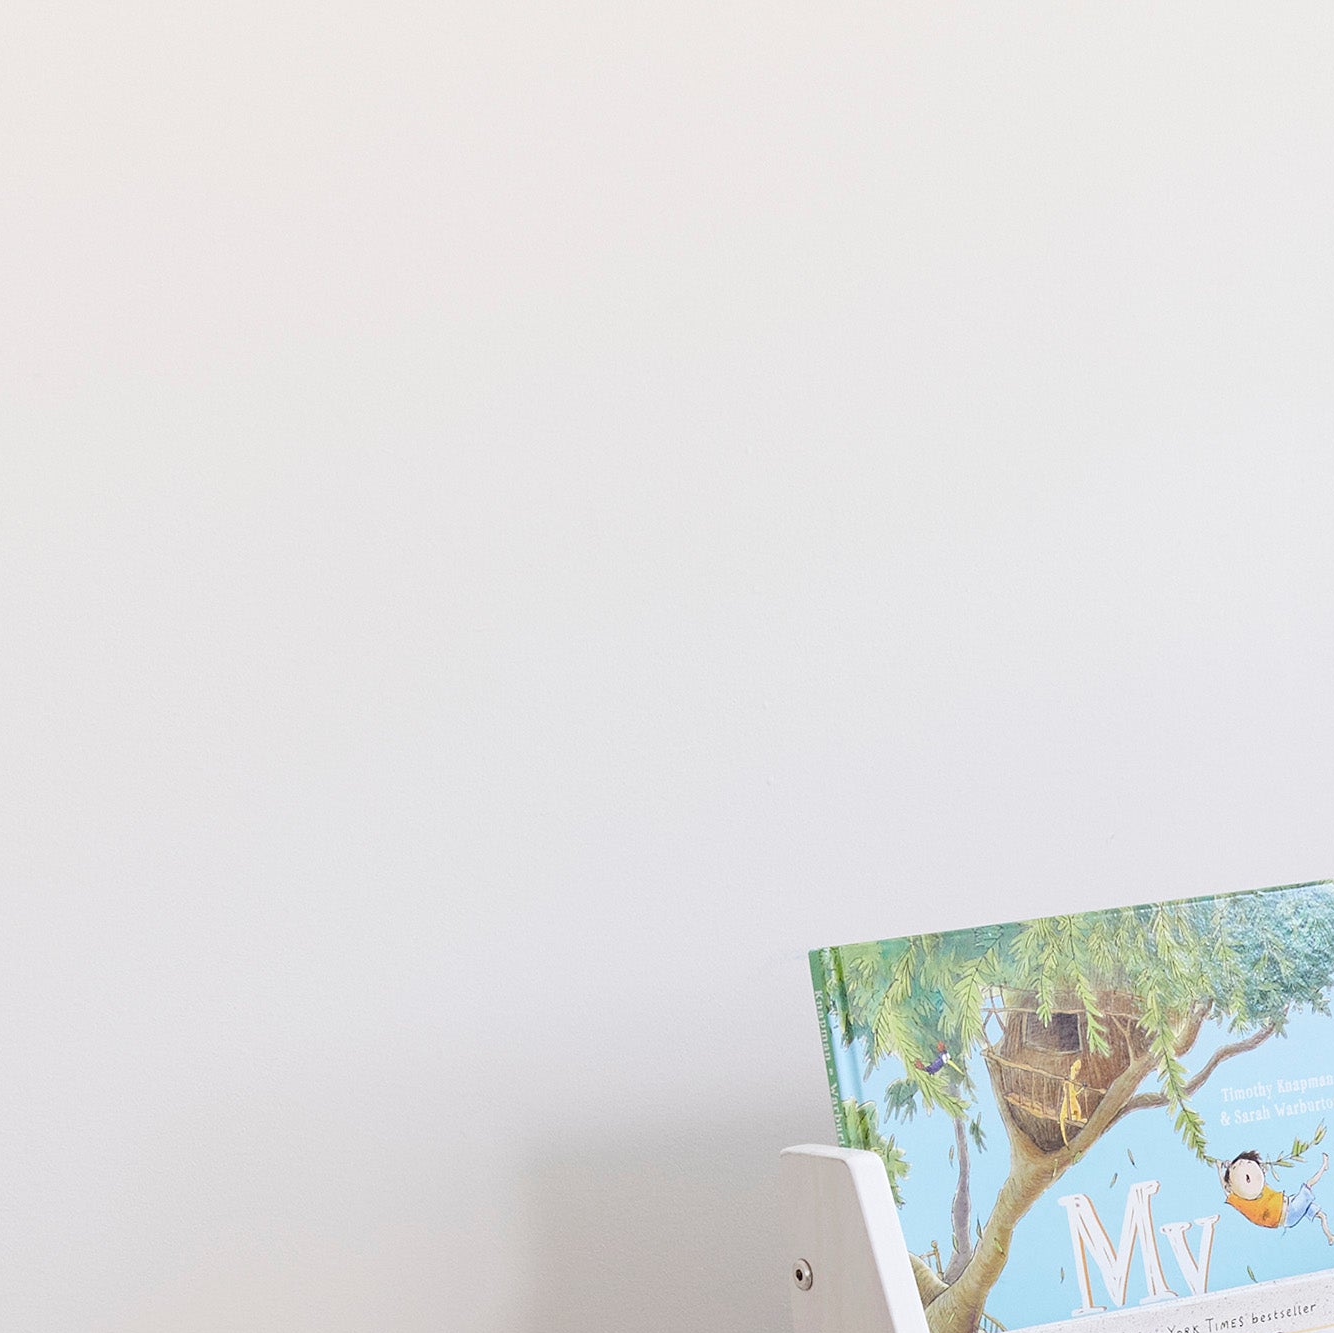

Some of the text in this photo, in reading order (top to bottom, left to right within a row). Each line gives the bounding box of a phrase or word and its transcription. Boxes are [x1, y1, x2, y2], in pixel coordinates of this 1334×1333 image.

[814, 989, 832, 1061] Knapman
[1220, 1074, 1334, 1103] Timothy Knapman
[1220, 1110, 1231, 1127] &
[1234, 1105, 1271, 1125] Sarah
[1056, 1180, 1222, 1317] My
[1251, 1303, 1317, 1325] bestseller
